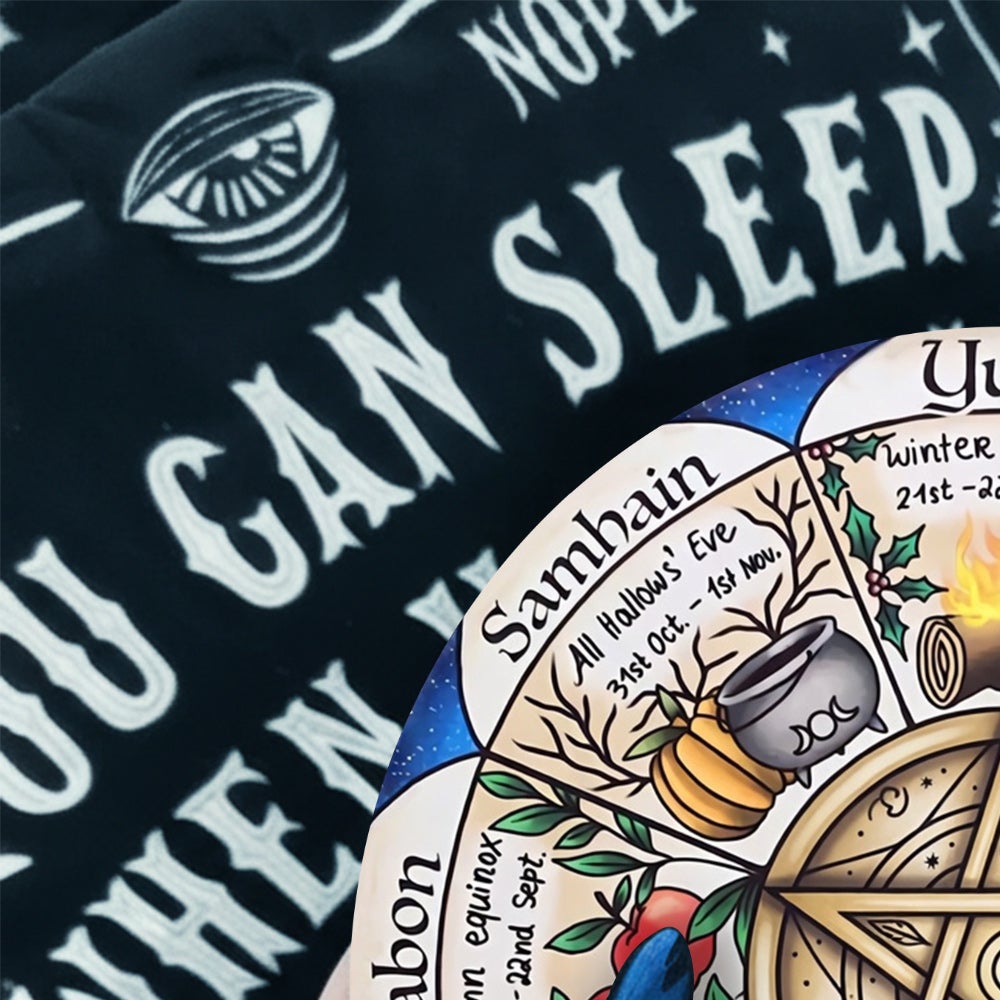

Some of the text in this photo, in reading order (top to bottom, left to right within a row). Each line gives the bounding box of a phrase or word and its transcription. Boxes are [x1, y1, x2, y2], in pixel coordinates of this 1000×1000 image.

[0, 537, 178, 815] OU
[145, 276, 501, 608] CAN
[492, 86, 978, 407] SLEEP
[481, 455, 721, 663] Samhain
[568, 633, 605, 686] All
[687, 522, 737, 561] Eve
[607, 652, 652, 700] 31st
[646, 614, 691, 656] Oct.
[707, 567, 737, 600] 1st
[739, 547, 782, 580] Nov.
[465, 832, 503, 946] equinox
[512, 852, 546, 909] Sept.
